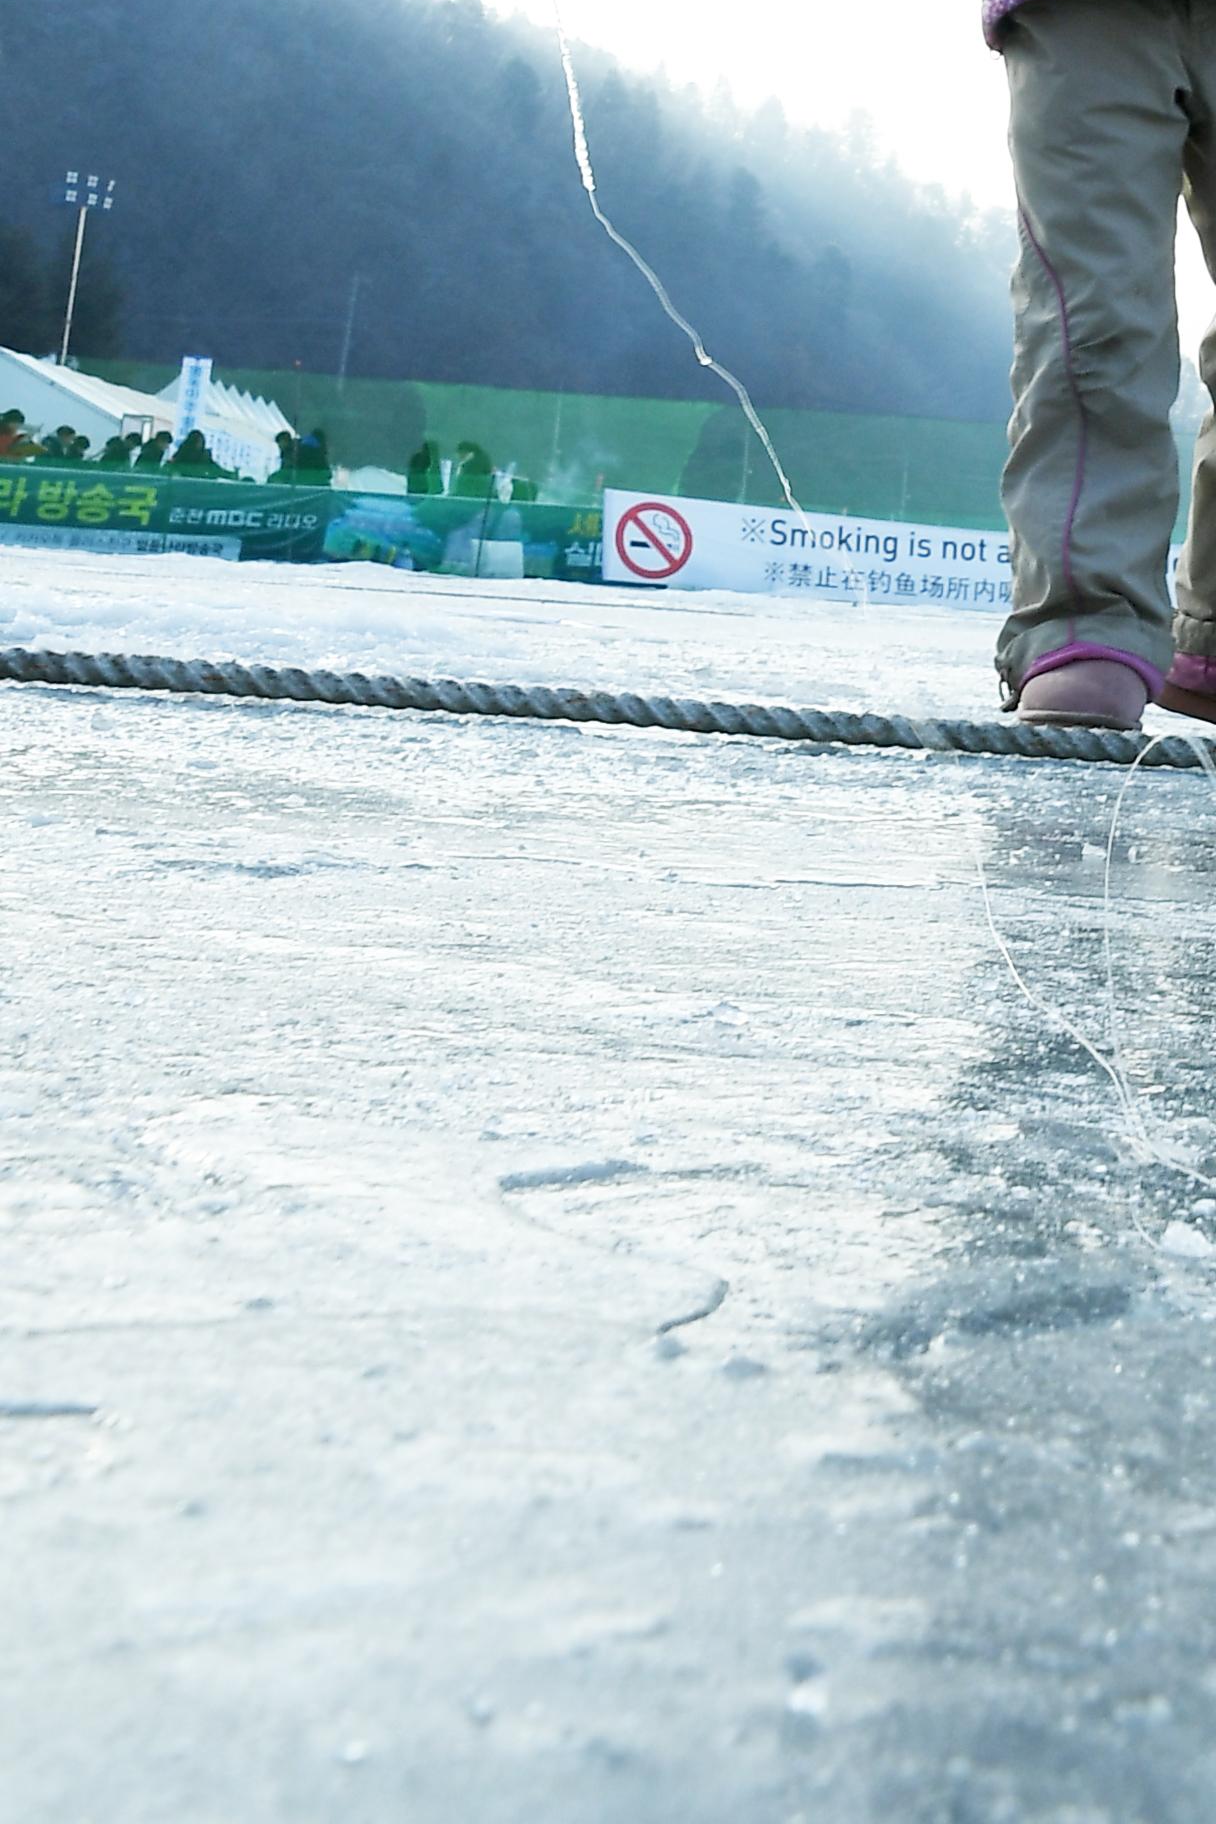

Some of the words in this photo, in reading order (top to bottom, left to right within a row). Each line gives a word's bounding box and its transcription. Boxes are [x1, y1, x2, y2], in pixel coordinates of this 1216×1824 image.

[37, 480, 158, 526] 방송국
[206, 509, 264, 528] MBC
[908, 531, 932, 559] is
[942, 538, 993, 562] not
